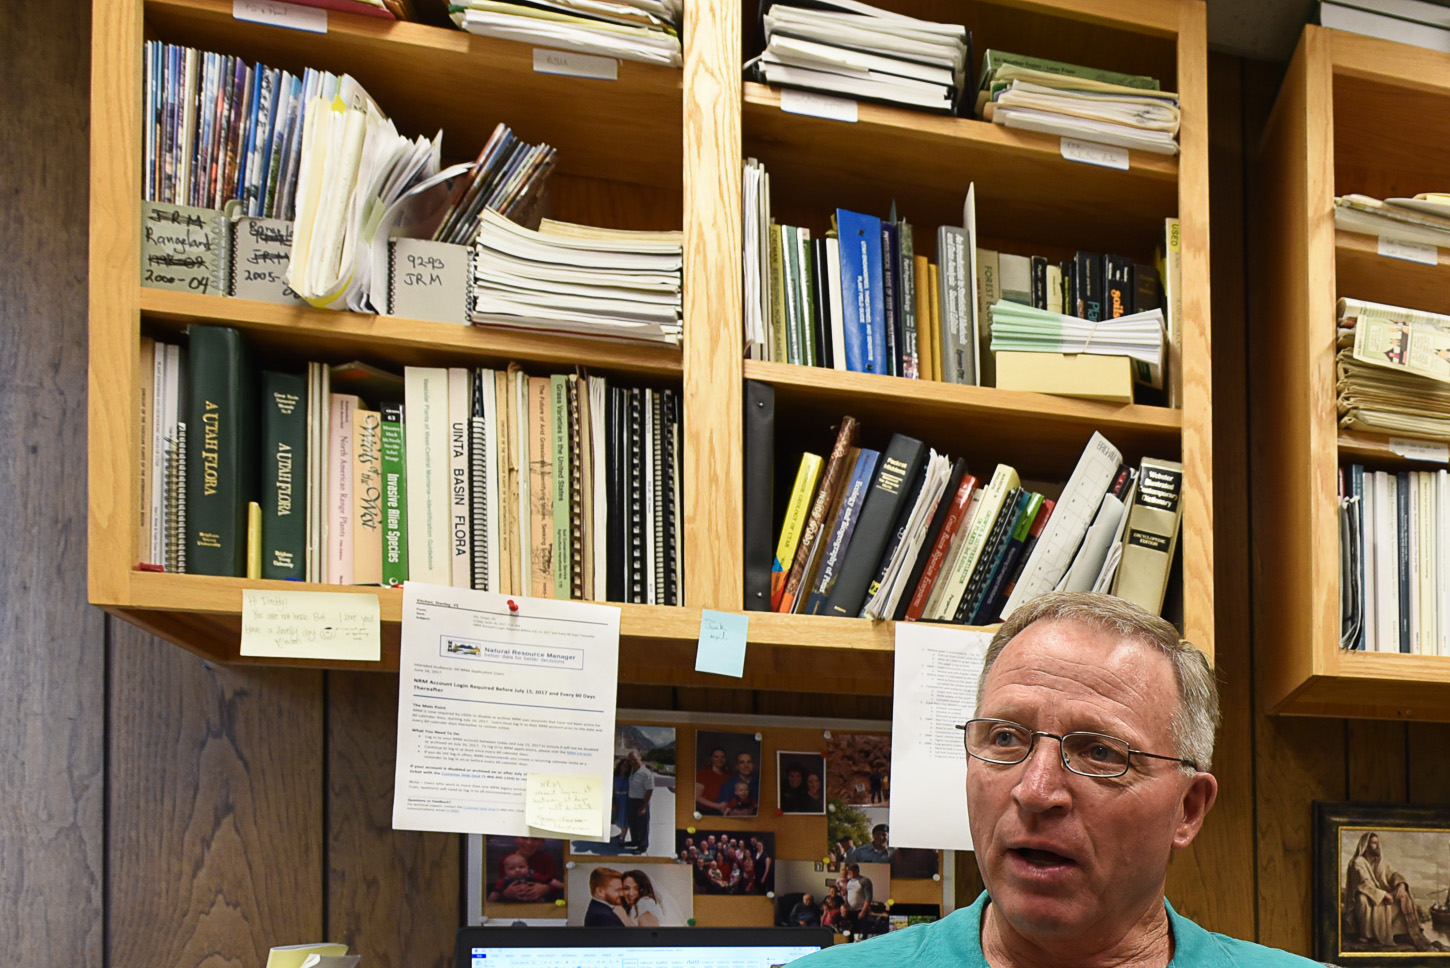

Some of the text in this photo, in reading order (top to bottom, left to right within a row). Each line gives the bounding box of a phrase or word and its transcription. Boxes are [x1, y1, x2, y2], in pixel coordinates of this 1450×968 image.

[145, 226, 212, 254] Rangeland
[1170, 223, 1180, 247] USED
[407, 254, 445, 270] 92-93
[145, 269, 209, 294] 2000-04
[403, 272, 443, 286] JRM
[1111, 289, 1124, 319] soils
[556, 383, 564, 404] Grass
[556, 405, 564, 434] Varieties
[202, 400, 219, 496] A UTAH FLORA
[339, 435, 348, 457] North
[358, 414, 382, 465] Weeds
[557, 456, 565, 479] United
[887, 457, 908, 469] Packrat
[276, 442, 292, 516] A UTAH FLORA
[339, 459, 348, 492] American
[1144, 477, 1175, 490] Illustrated
[1148, 470, 1174, 482] Webster
[453, 422, 466, 556] UINTA BASIN FLORA
[557, 479, 565, 502] States
[848, 479, 863, 508] Ecology
[1138, 485, 1178, 501] Contemporary
[338, 493, 347, 514] Range
[360, 487, 383, 533] West
[792, 493, 804, 522] GEOLOGY
[1141, 494, 1172, 508] Dictionary
[339, 516, 348, 538] Plants
[386, 473, 401, 563] Invasive Alien Species
[789, 522, 797, 532] OF
[802, 490, 827, 546] INSIDE WOOD
[785, 531, 795, 549] UTAH
[828, 521, 849, 566] Biogeography
[914, 513, 958, 608] Great Basin Riparian Ecosystems
[819, 574, 831, 593] Pinus
[484, 646, 576, 661] Natural Resource Manager
[413, 685, 444, 693] Thereafter
[430, 679, 453, 687] Account
[453, 681, 469, 689] Login
[470, 683, 495, 692] Required
[559, 691, 574, 699] Every
